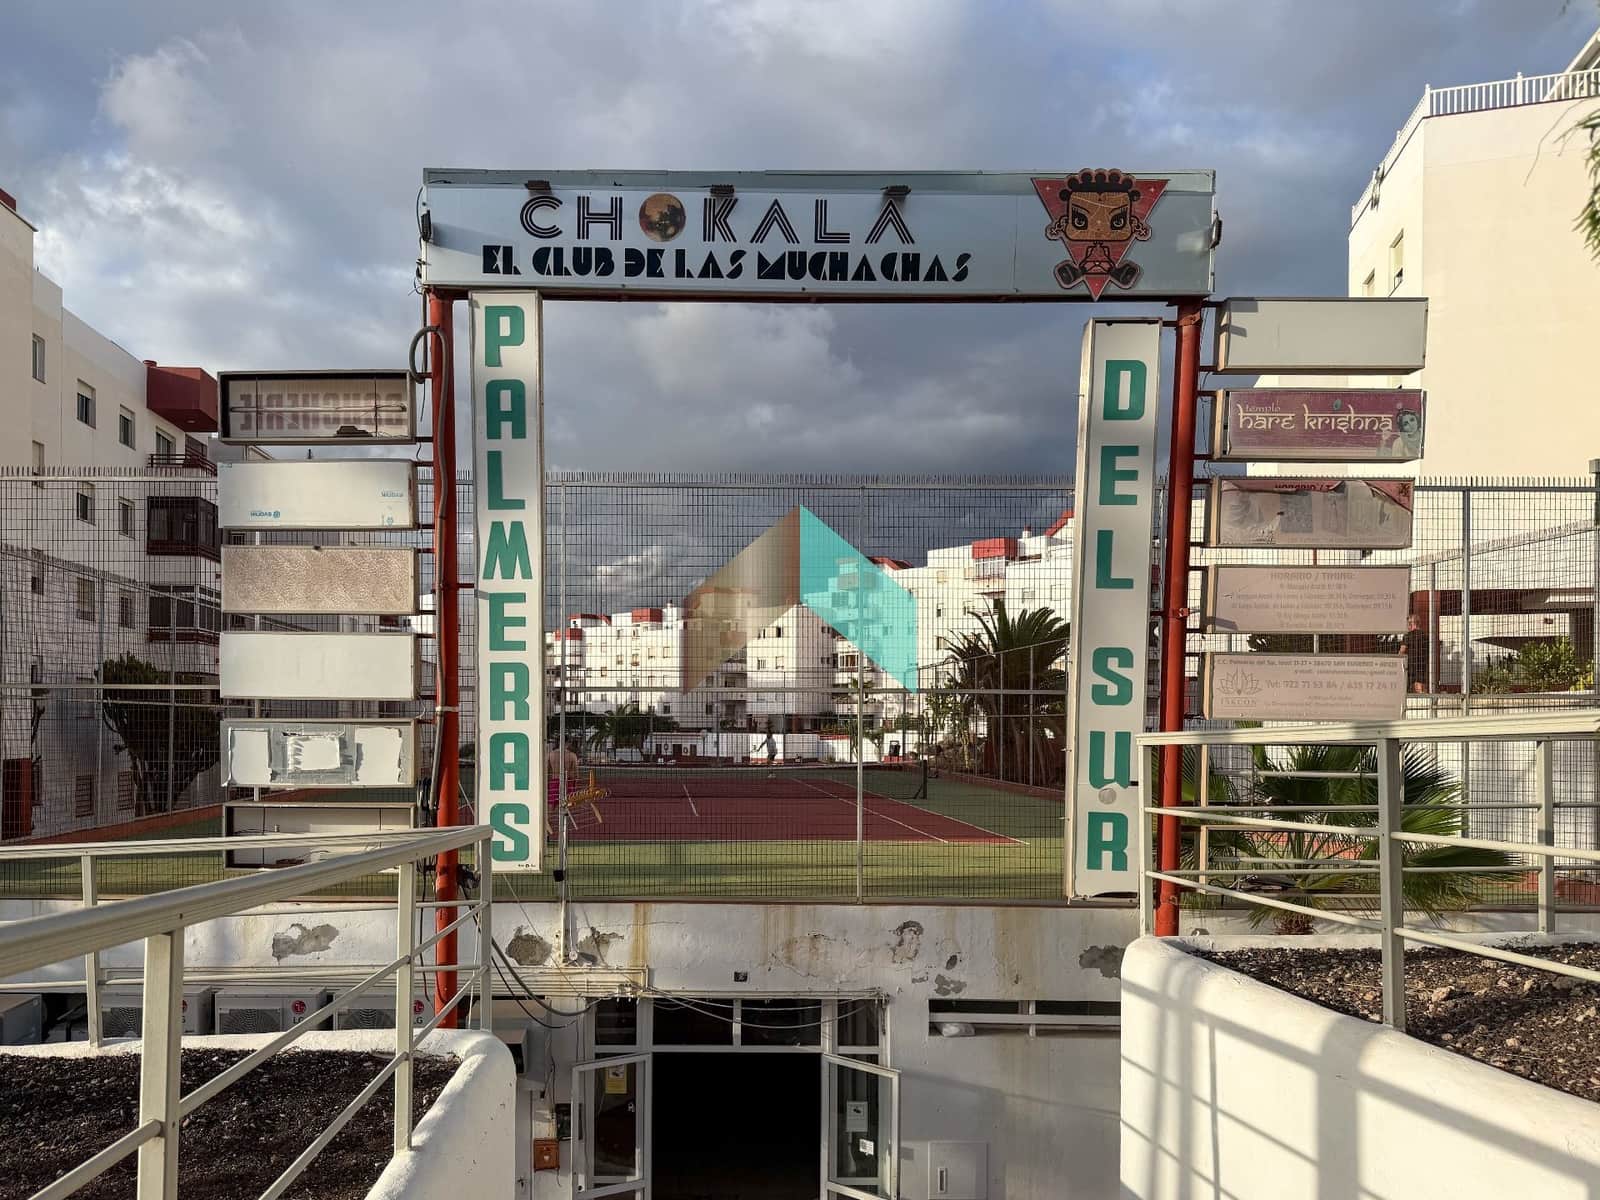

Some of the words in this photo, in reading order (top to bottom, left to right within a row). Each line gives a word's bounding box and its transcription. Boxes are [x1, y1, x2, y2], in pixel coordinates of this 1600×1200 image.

[482, 245, 522, 276] EL
[531, 246, 616, 278] CLUB
[624, 248, 666, 279] DE
[674, 249, 748, 281] LAS
[756, 250, 972, 283] MUCHACHAS
[1096, 360, 1147, 589] DEL
[1237, 403, 1296, 430] hare
[1303, 404, 1393, 433] krishna
[483, 306, 533, 861] PALMERAS
[1087, 647, 1134, 871] SUR
